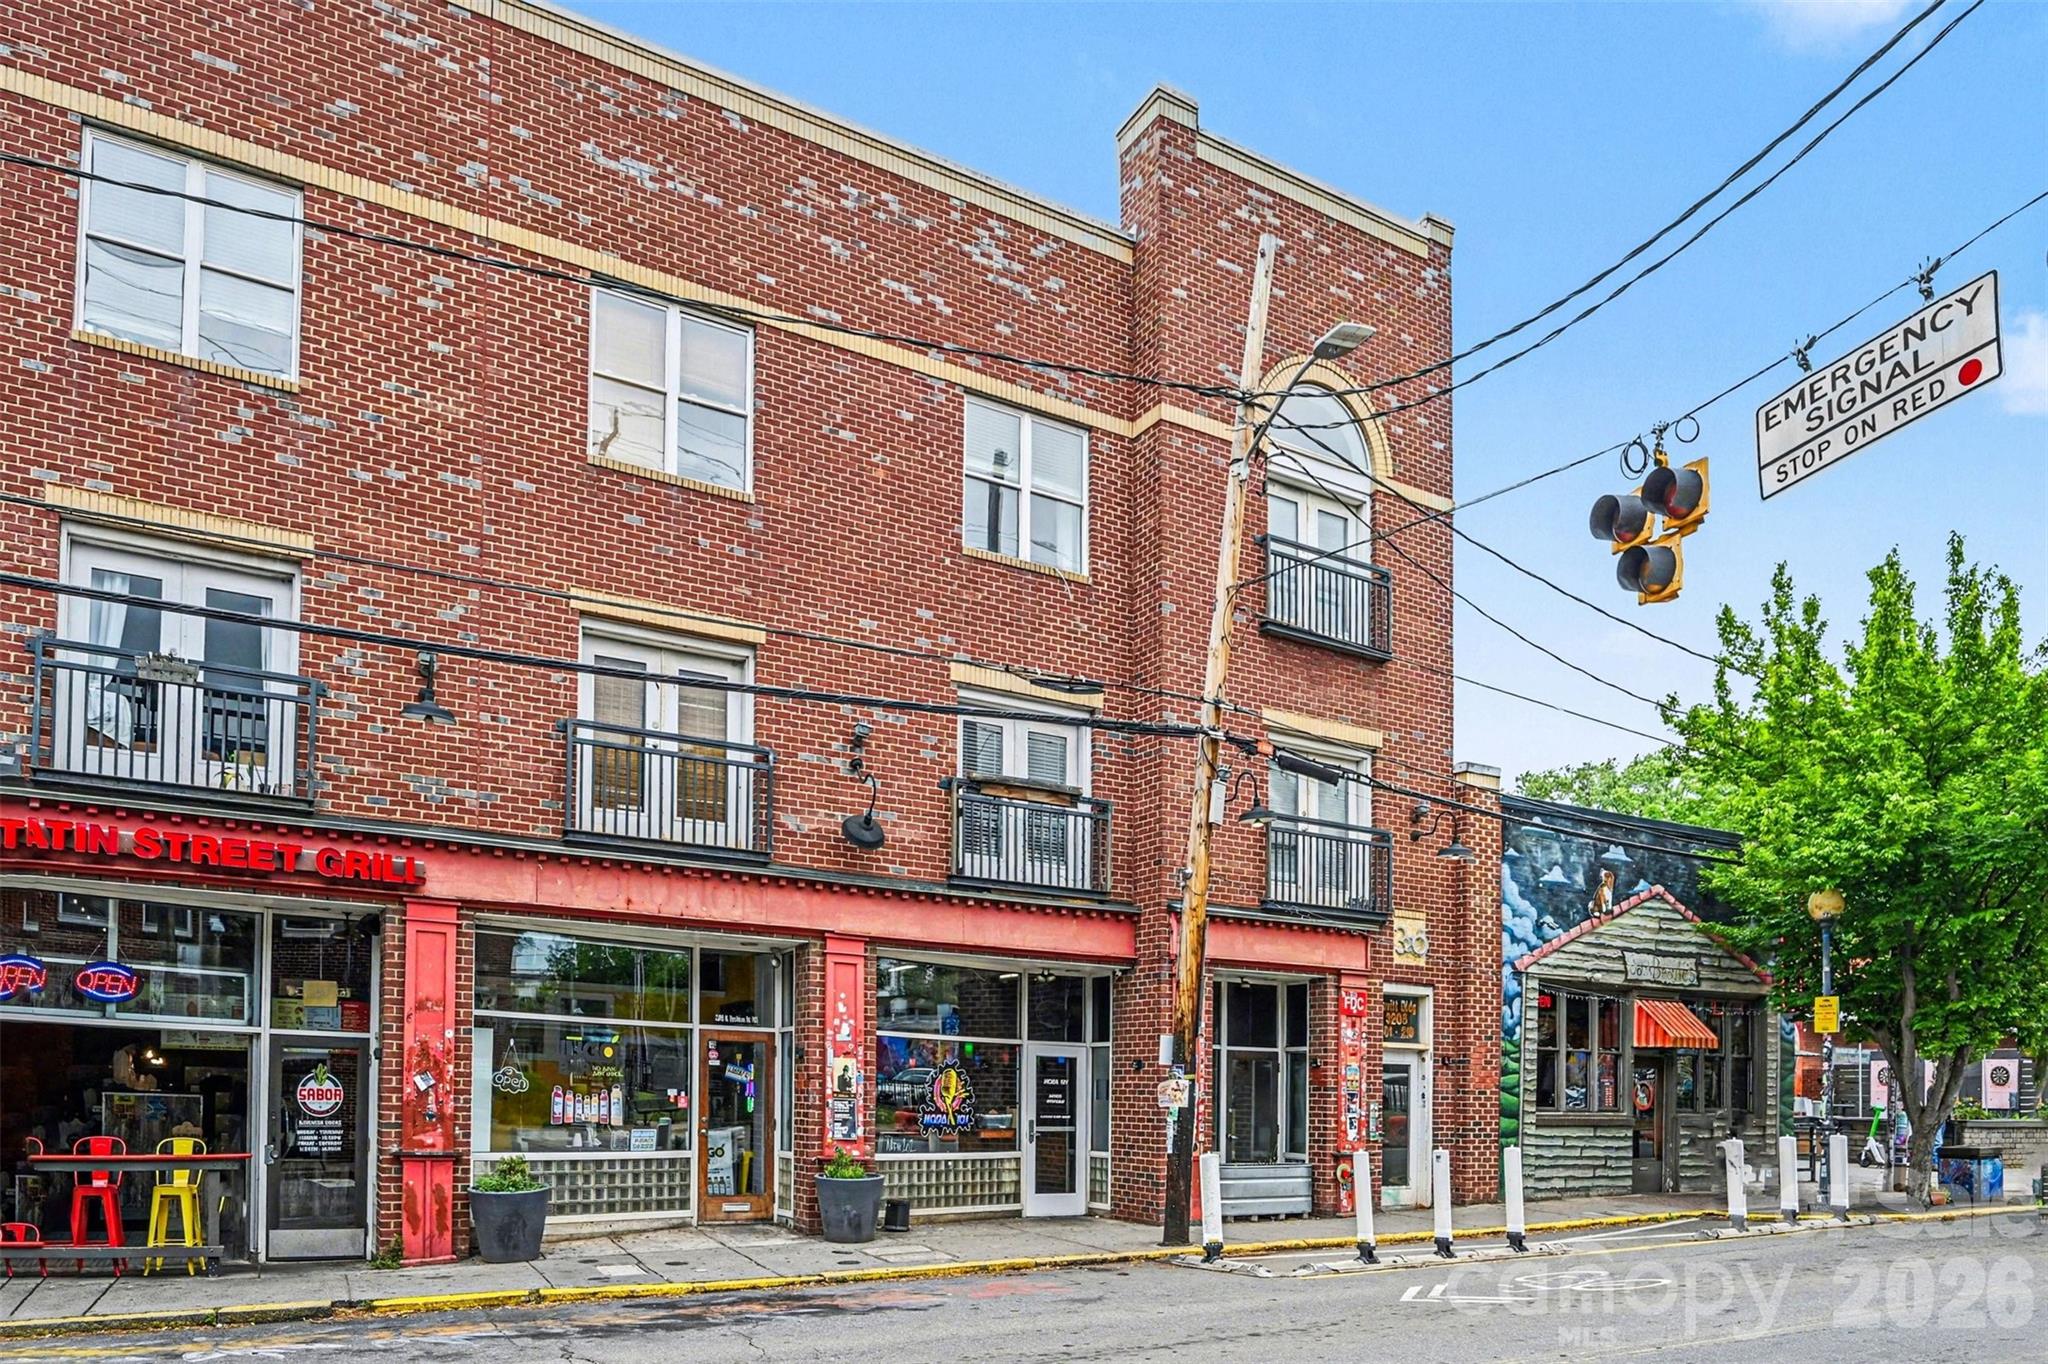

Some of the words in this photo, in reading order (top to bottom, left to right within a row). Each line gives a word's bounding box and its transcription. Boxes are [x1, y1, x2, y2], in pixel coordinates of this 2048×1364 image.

[1765, 284, 1983, 432] EMERGENCY
[1805, 350, 1935, 433] SIGNAL
[1776, 439, 1831, 484] STOP
[1844, 413, 1877, 446] ON
[1892, 379, 1945, 421] RED
[132, 827, 302, 873] STREET
[315, 847, 427, 886] GRILL
[76, 971, 138, 994] OPEN
[1343, 996, 1365, 1011] FDC
[298, 1088, 342, 1101] SABOR
